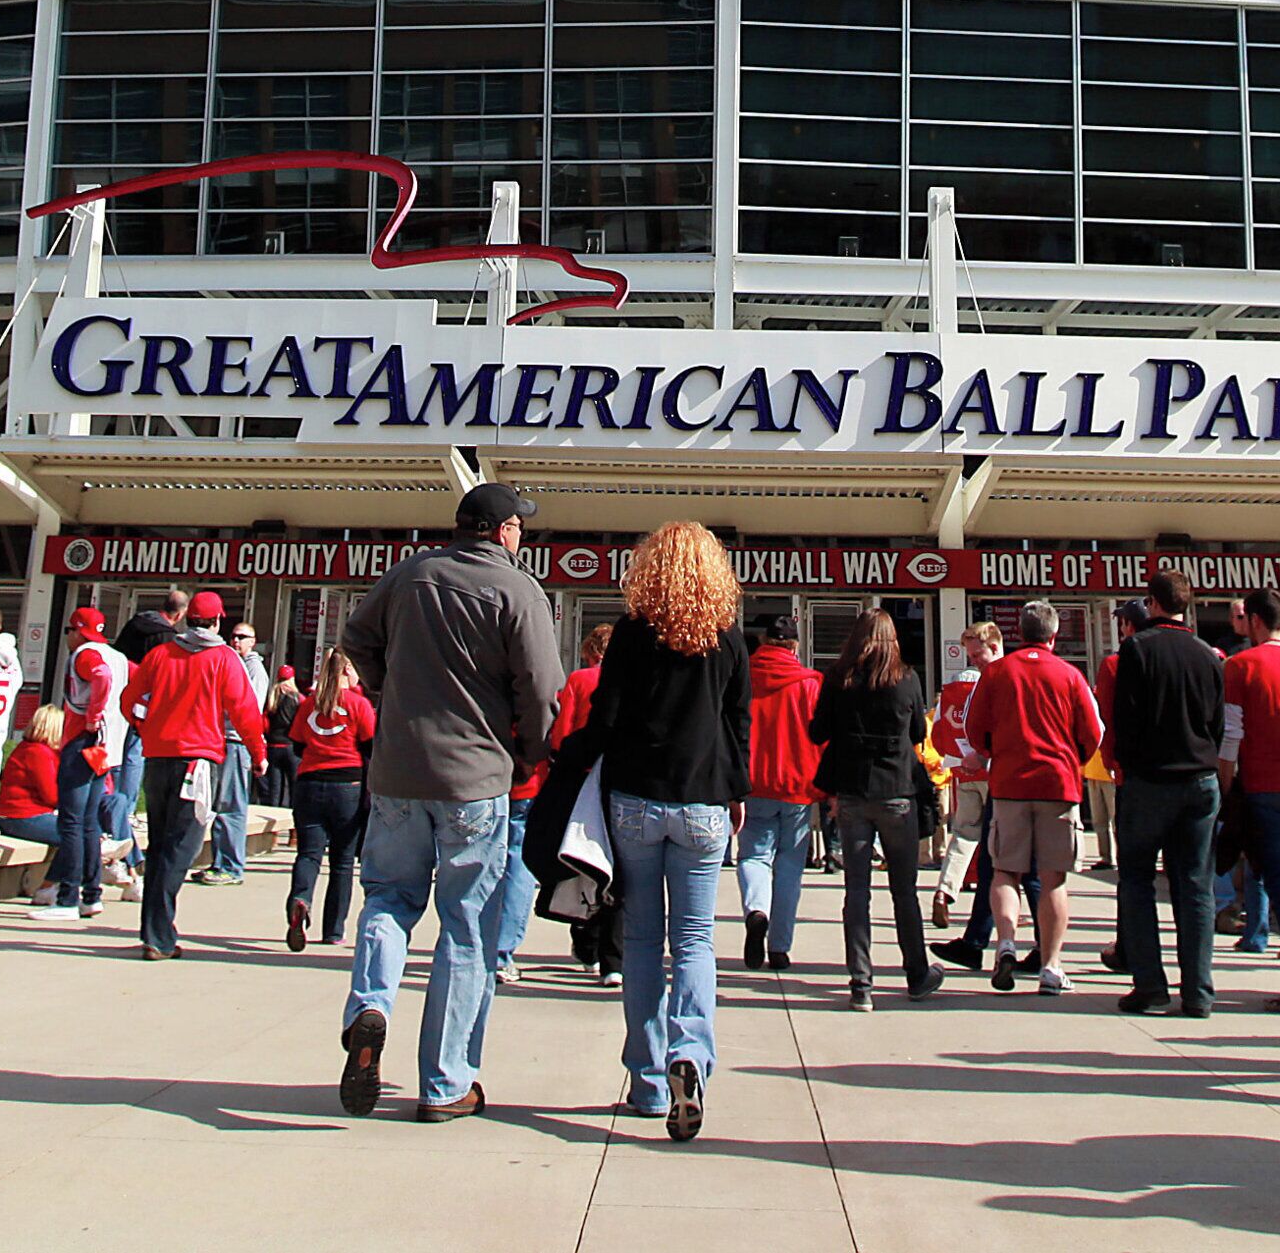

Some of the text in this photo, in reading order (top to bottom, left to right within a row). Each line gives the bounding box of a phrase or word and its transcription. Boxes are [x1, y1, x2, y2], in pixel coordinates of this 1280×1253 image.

[50, 314, 375, 399] GREAT
[334, 344, 858, 433] AMERICAN
[873, 351, 1125, 439] BALL
[102, 540, 229, 575] HAMILTON
[238, 542, 338, 576] COUNTY
[518, 547, 550, 580] OU
[570, 559, 599, 568] REDS
[844, 552, 899, 584] WAY
[918, 563, 949, 574] REDS
[982, 553, 1054, 586] HOME
[1062, 555, 1092, 587] OF
[1101, 555, 1148, 588] THE
